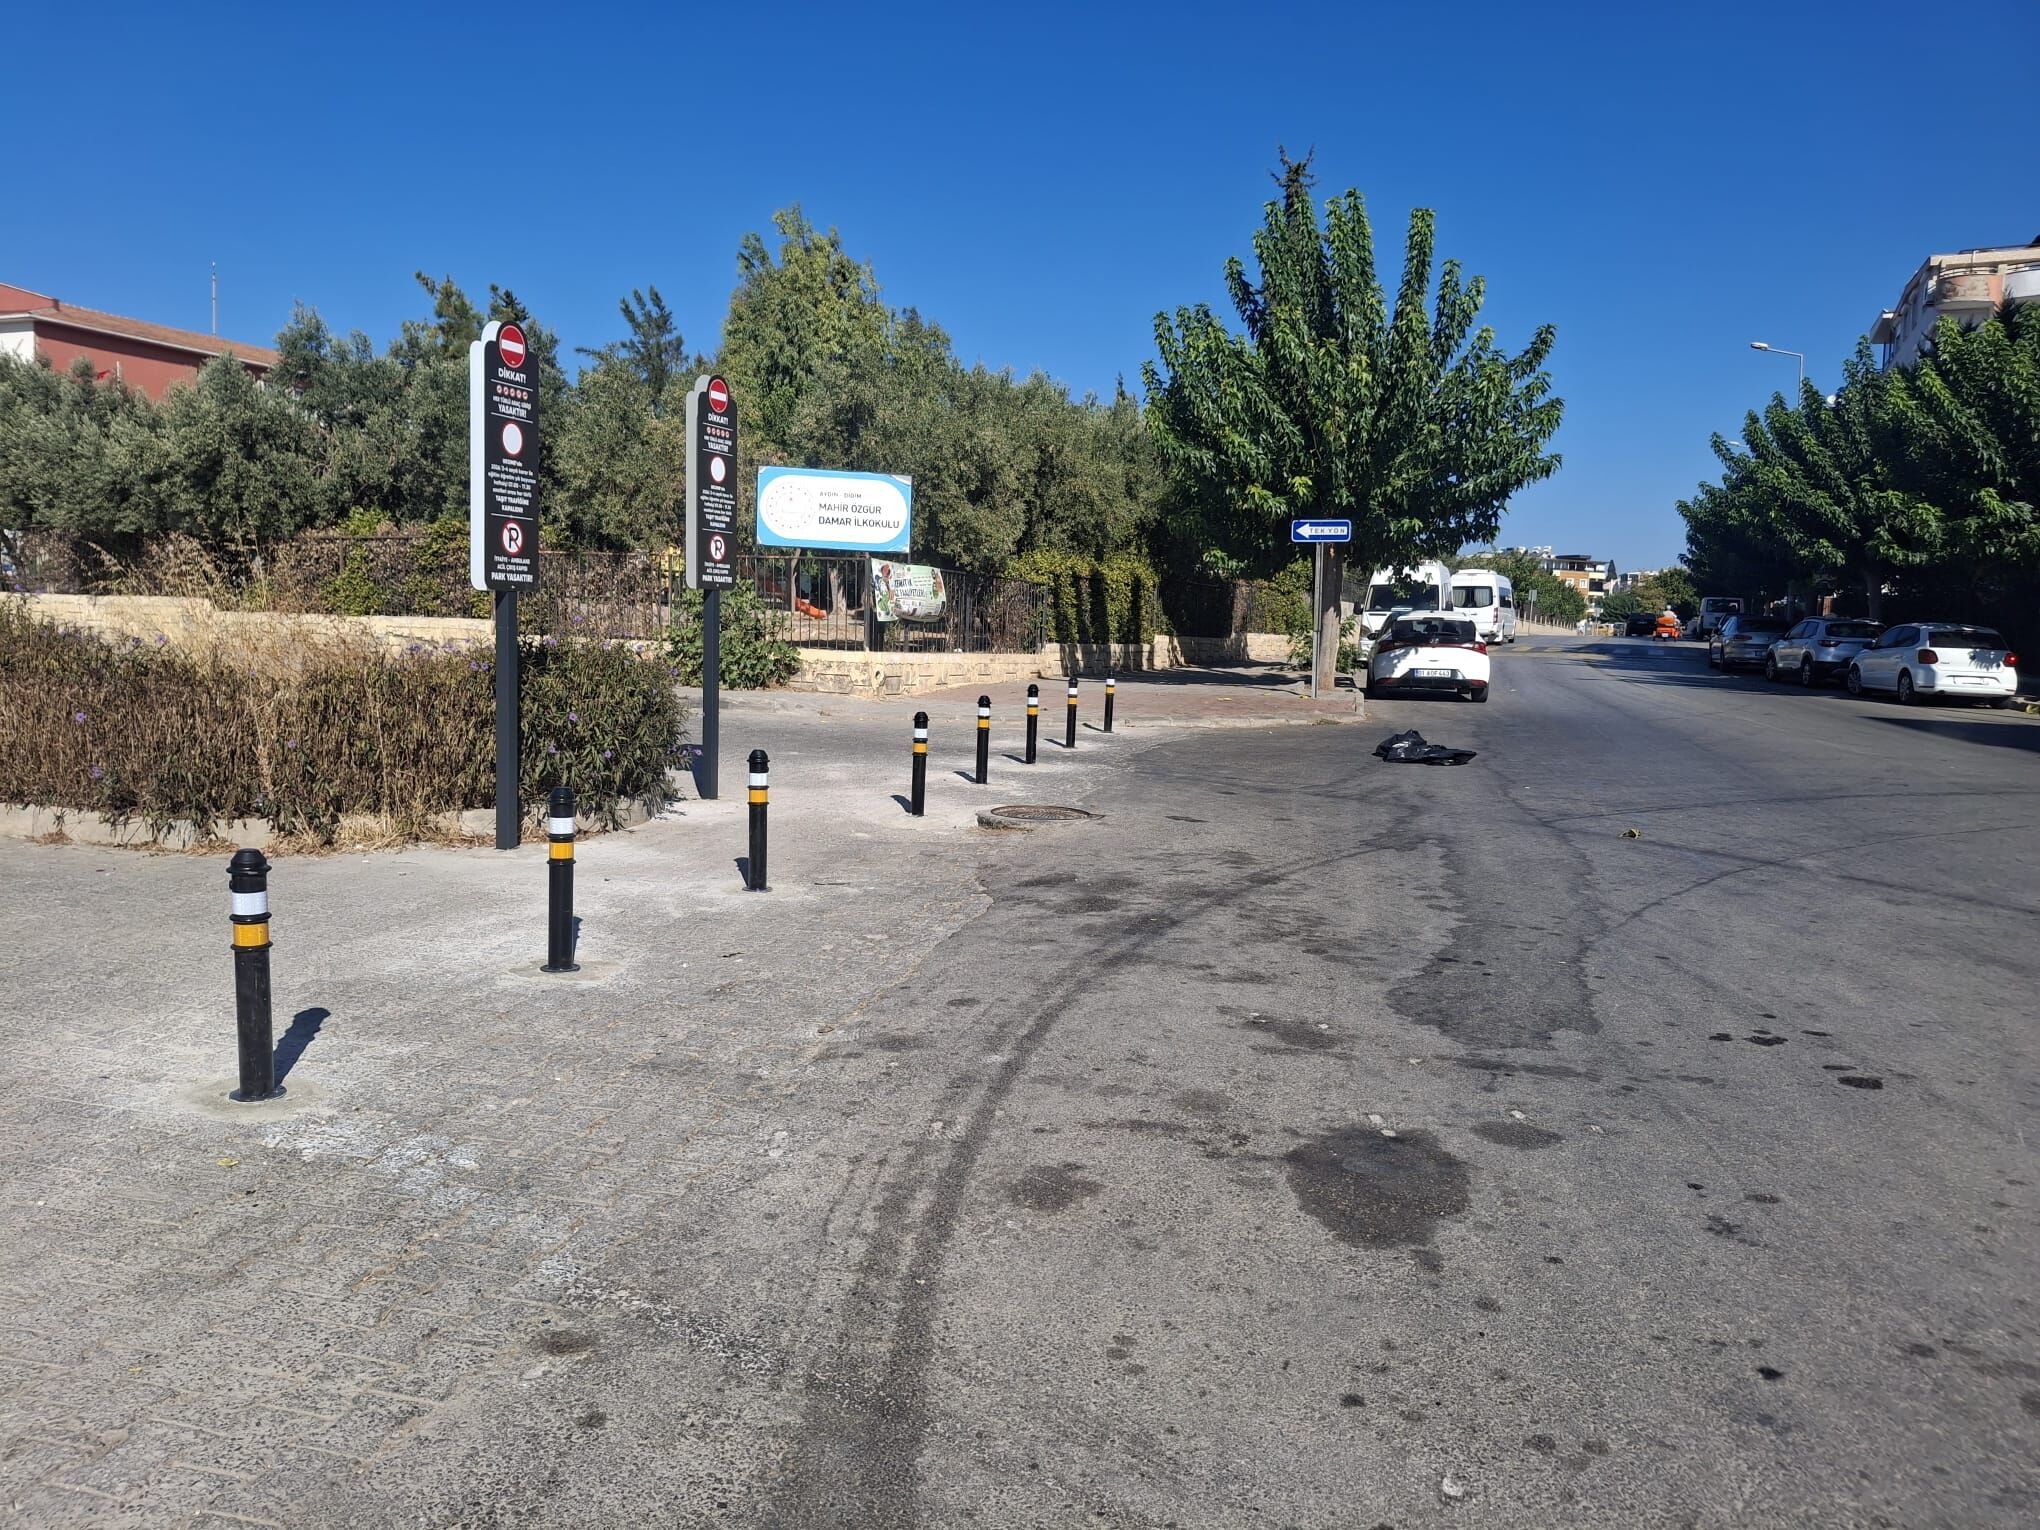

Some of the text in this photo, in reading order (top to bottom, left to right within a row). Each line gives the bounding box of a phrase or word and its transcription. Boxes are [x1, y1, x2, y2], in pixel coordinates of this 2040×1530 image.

[818, 502, 882, 514] MAHİR ÖZGÜR
[818, 516, 900, 529] DAMAR İLKOKULU
